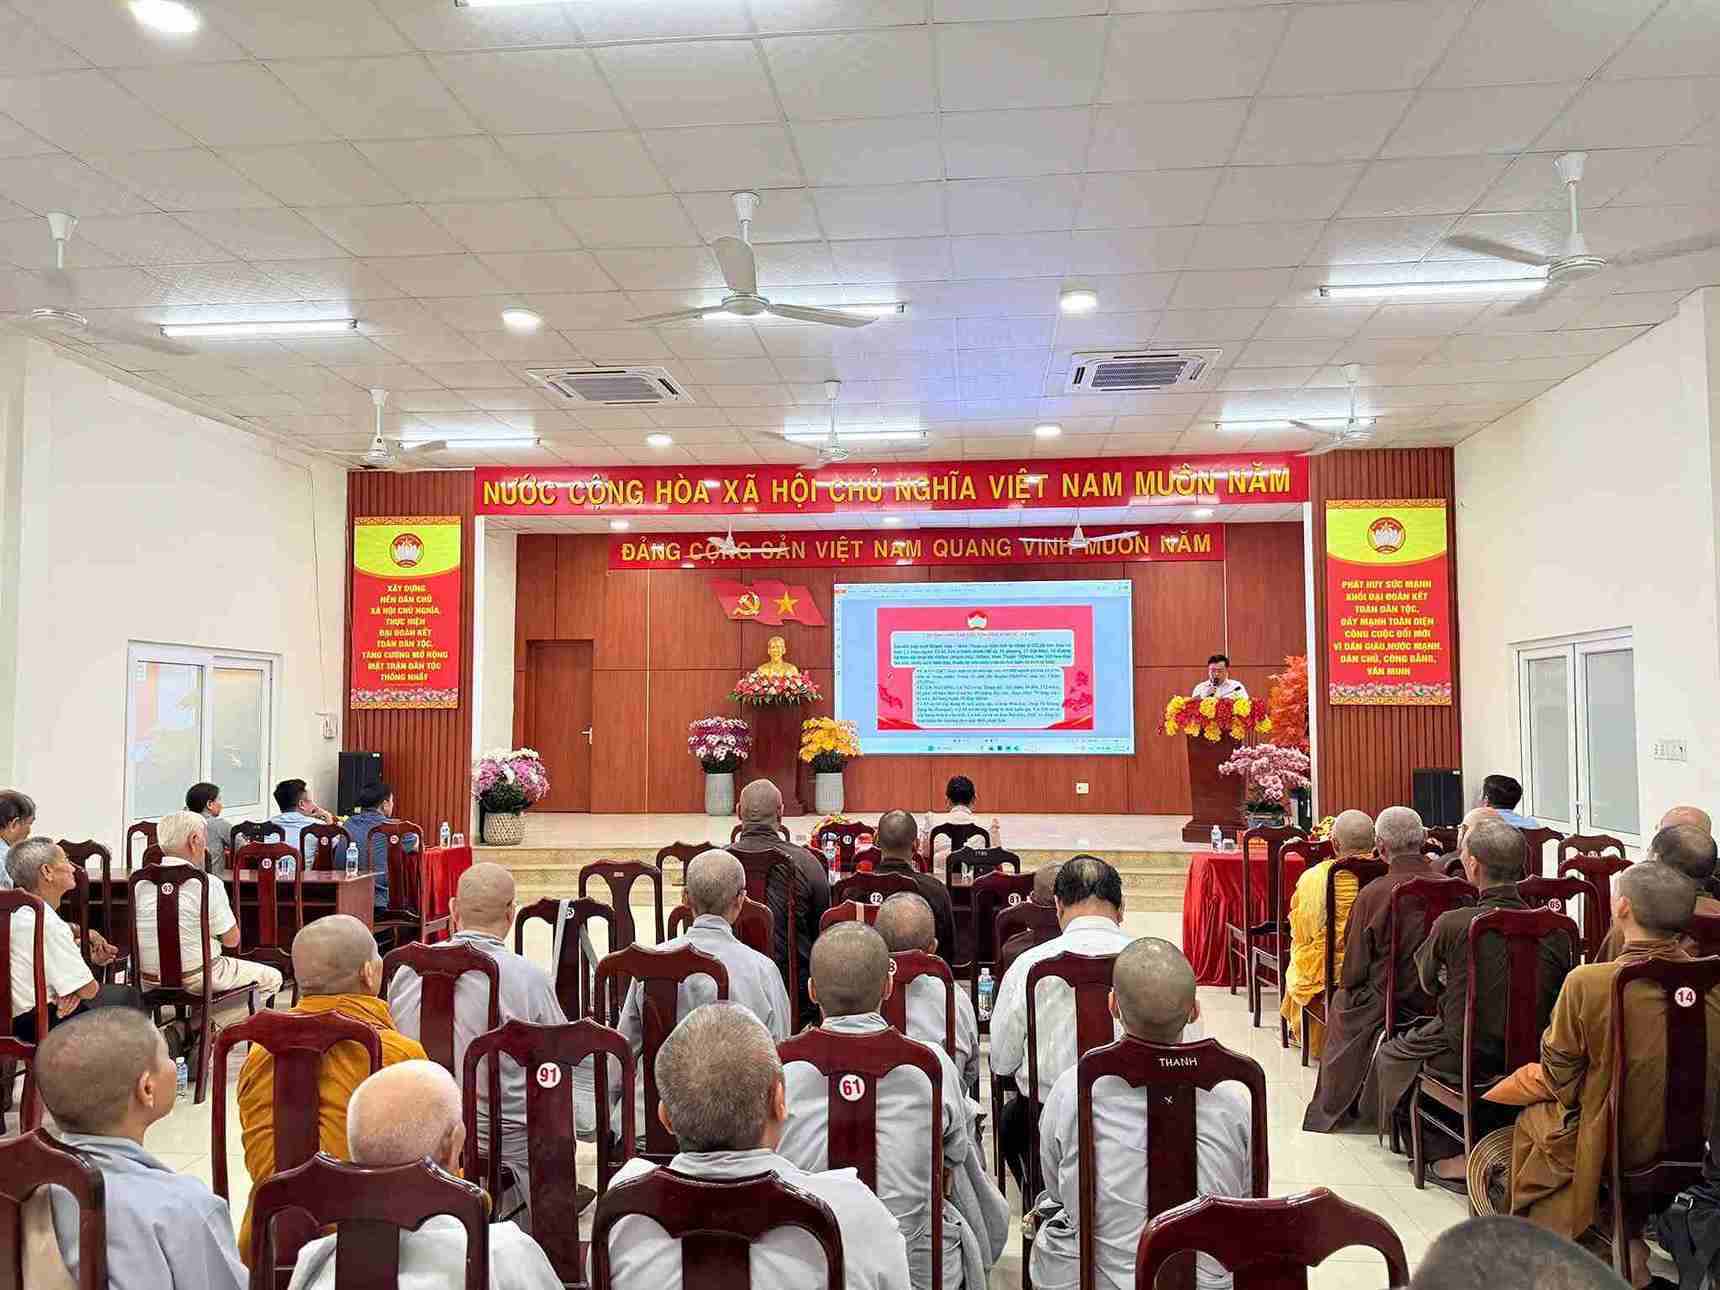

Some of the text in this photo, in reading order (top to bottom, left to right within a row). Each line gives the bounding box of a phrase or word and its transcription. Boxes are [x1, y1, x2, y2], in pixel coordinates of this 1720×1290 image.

[483, 474, 557, 505] NƯỚC
[569, 473, 645, 510] CỘNG
[655, 474, 711, 504] HÒA
[723, 473, 760, 504] XÃ
[771, 472, 817, 507] HỘI
[828, 467, 883, 503] CHỦ
[895, 470, 977, 502] NGHĨA
[988, 468, 1048, 504] VIỆT
[1062, 471, 1122, 497] NAM
[1228, 461, 1291, 494] NĂM
[621, 536, 681, 561] ĐẢNG
[816, 536, 863, 563] VIỆT
[874, 539, 921, 558] NAM
[933, 537, 1013, 558] QUANG
[1160, 529, 1211, 553] NĂM
[1678, 990, 1693, 1002] 14
[1159, 1057, 1198, 1067] THANH
[540, 1067, 557, 1082] 91
[843, 1079, 861, 1096] 61
